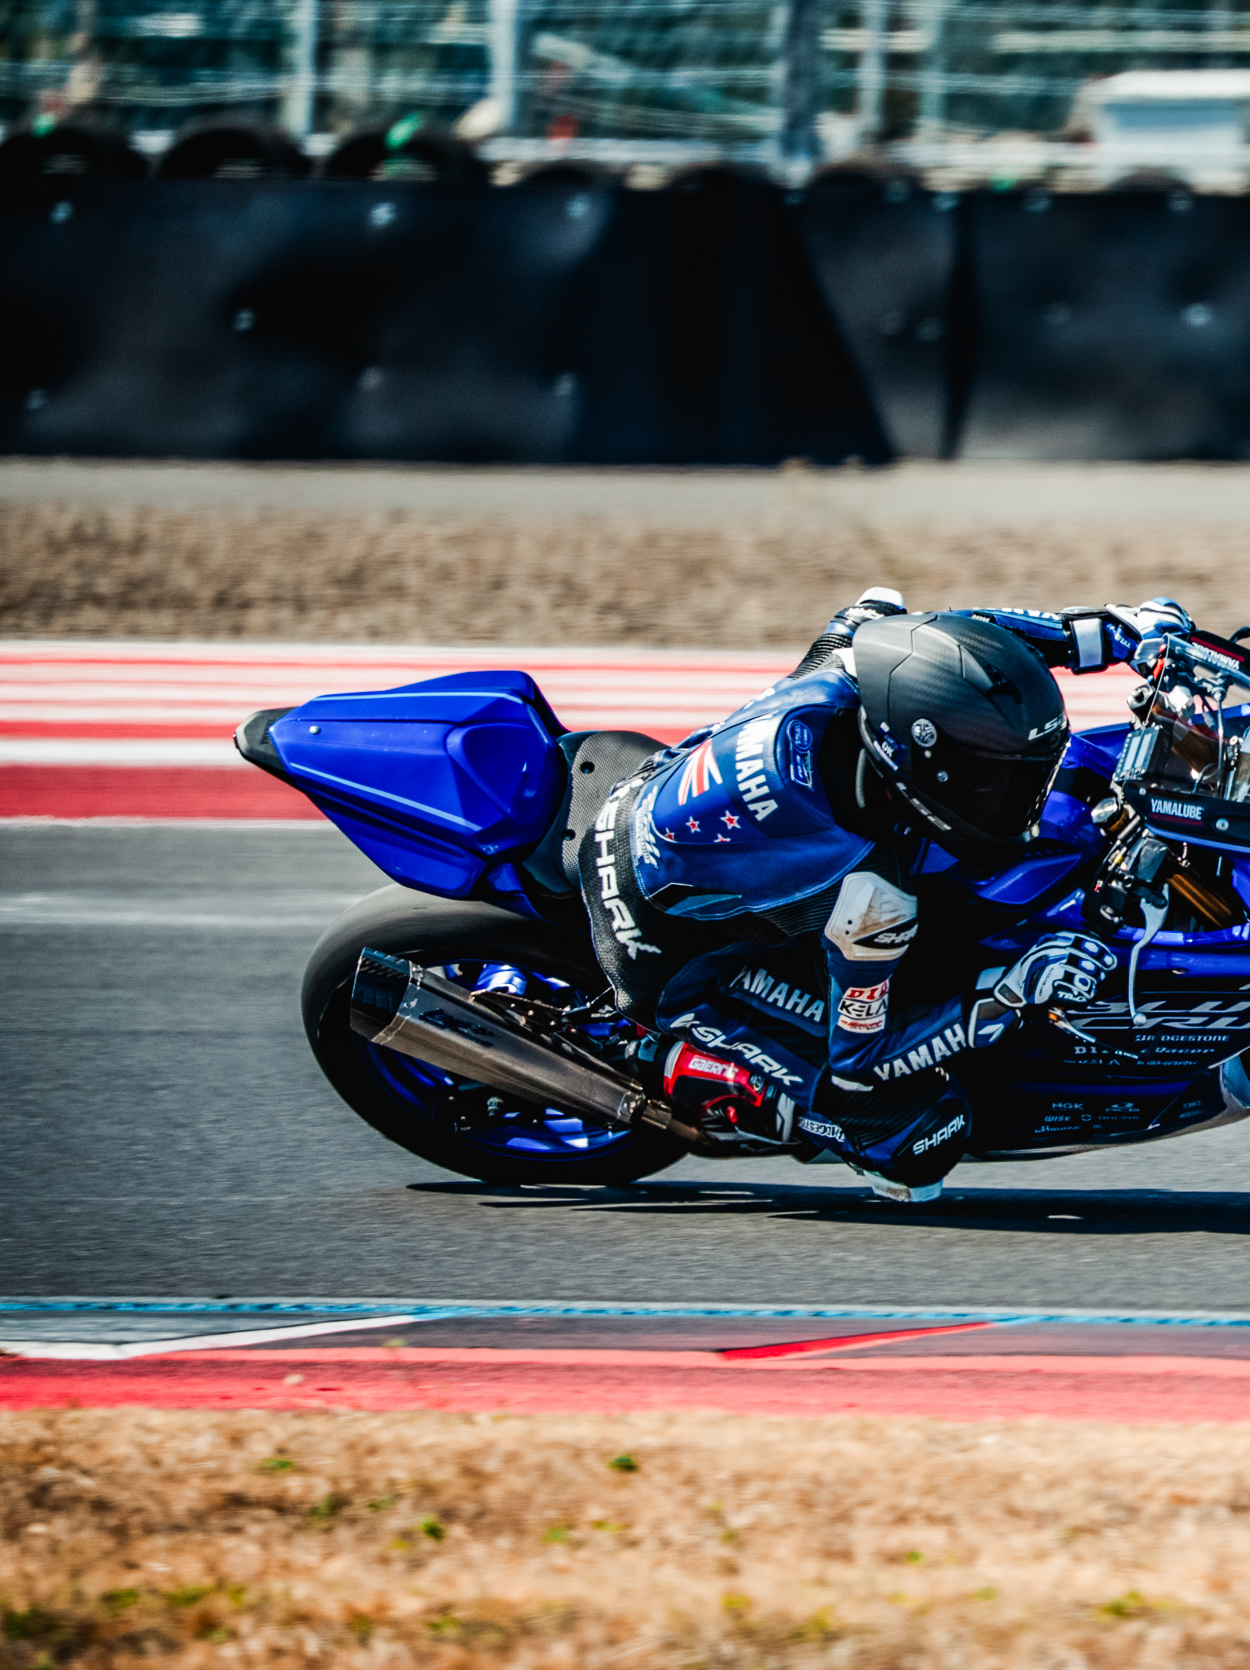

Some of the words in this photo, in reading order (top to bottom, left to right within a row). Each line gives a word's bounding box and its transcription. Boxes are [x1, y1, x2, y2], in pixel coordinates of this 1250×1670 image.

[1151, 799, 1203, 820] YAMALUBE
[690, 1026, 804, 1086] SHARK
[873, 1023, 967, 1081] YAMAH
[912, 1113, 966, 1155] SHARK
